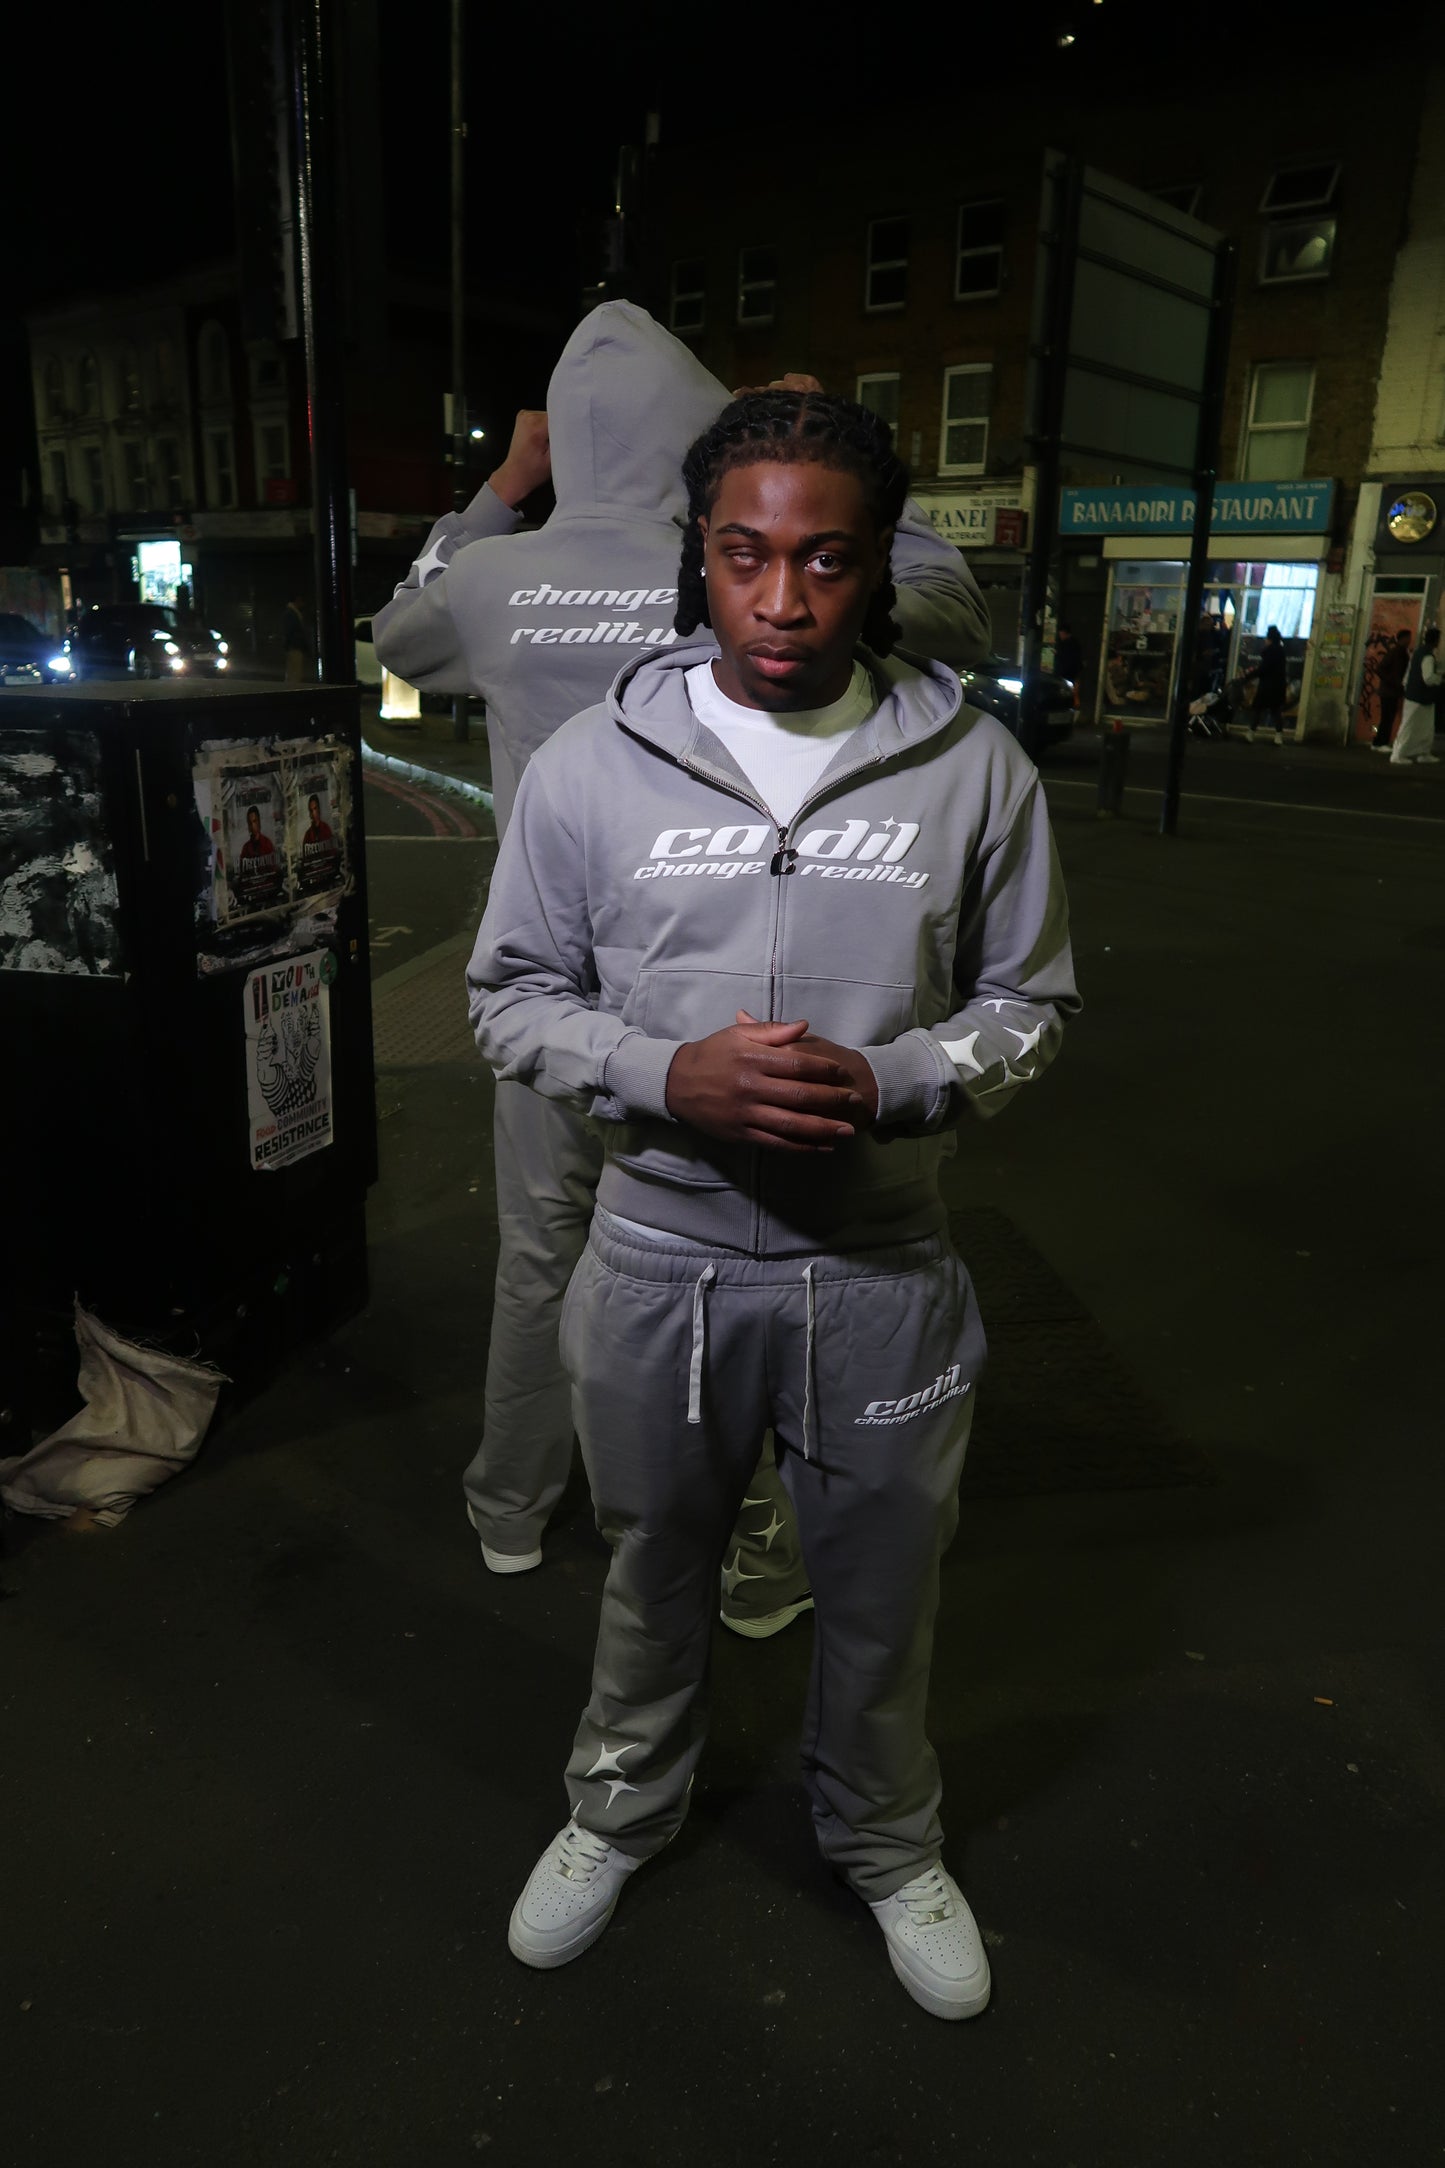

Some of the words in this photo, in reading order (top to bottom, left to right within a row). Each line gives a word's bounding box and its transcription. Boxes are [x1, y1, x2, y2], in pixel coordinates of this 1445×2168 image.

[1072, 499, 1175, 524] BANAADIRI
[1181, 495, 1319, 521] RSTAURANT
[508, 584, 679, 611] change
[510, 622, 678, 650] reality
[633, 860, 766, 880] change
[800, 863, 930, 889] reality
[272, 963, 315, 993] YOUTH
[255, 1112, 329, 1162] RESISTANCE
[854, 1408, 920, 1425] change
[923, 1382, 971, 1414] reality
